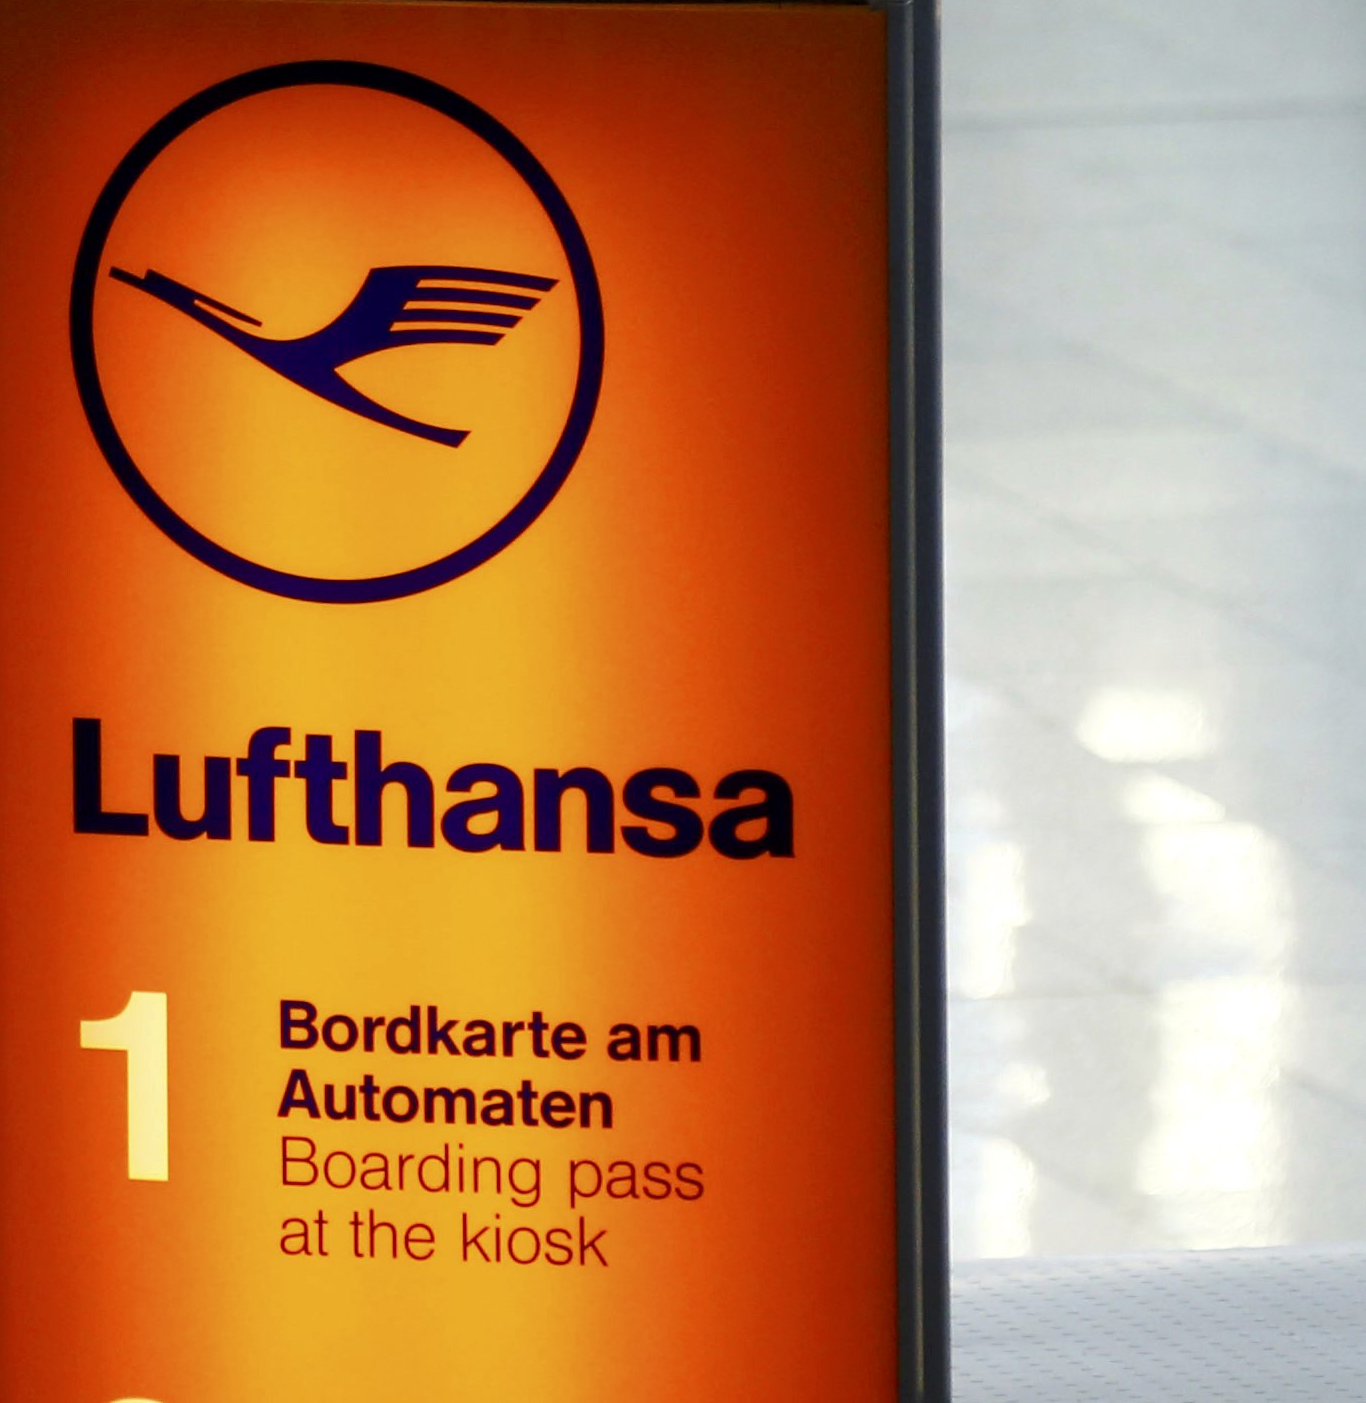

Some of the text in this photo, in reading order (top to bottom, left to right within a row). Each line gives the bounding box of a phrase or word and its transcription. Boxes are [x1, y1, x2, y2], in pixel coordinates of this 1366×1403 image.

[71, 715, 797, 862] Lufthansa
[278, 998, 703, 1064] Bordkarte am
[79, 990, 170, 1182] 1
[276, 1067, 614, 1130] Automaten
[280, 1135, 706, 1210] Boarding pass
[279, 1208, 609, 1268] at the kiosk
